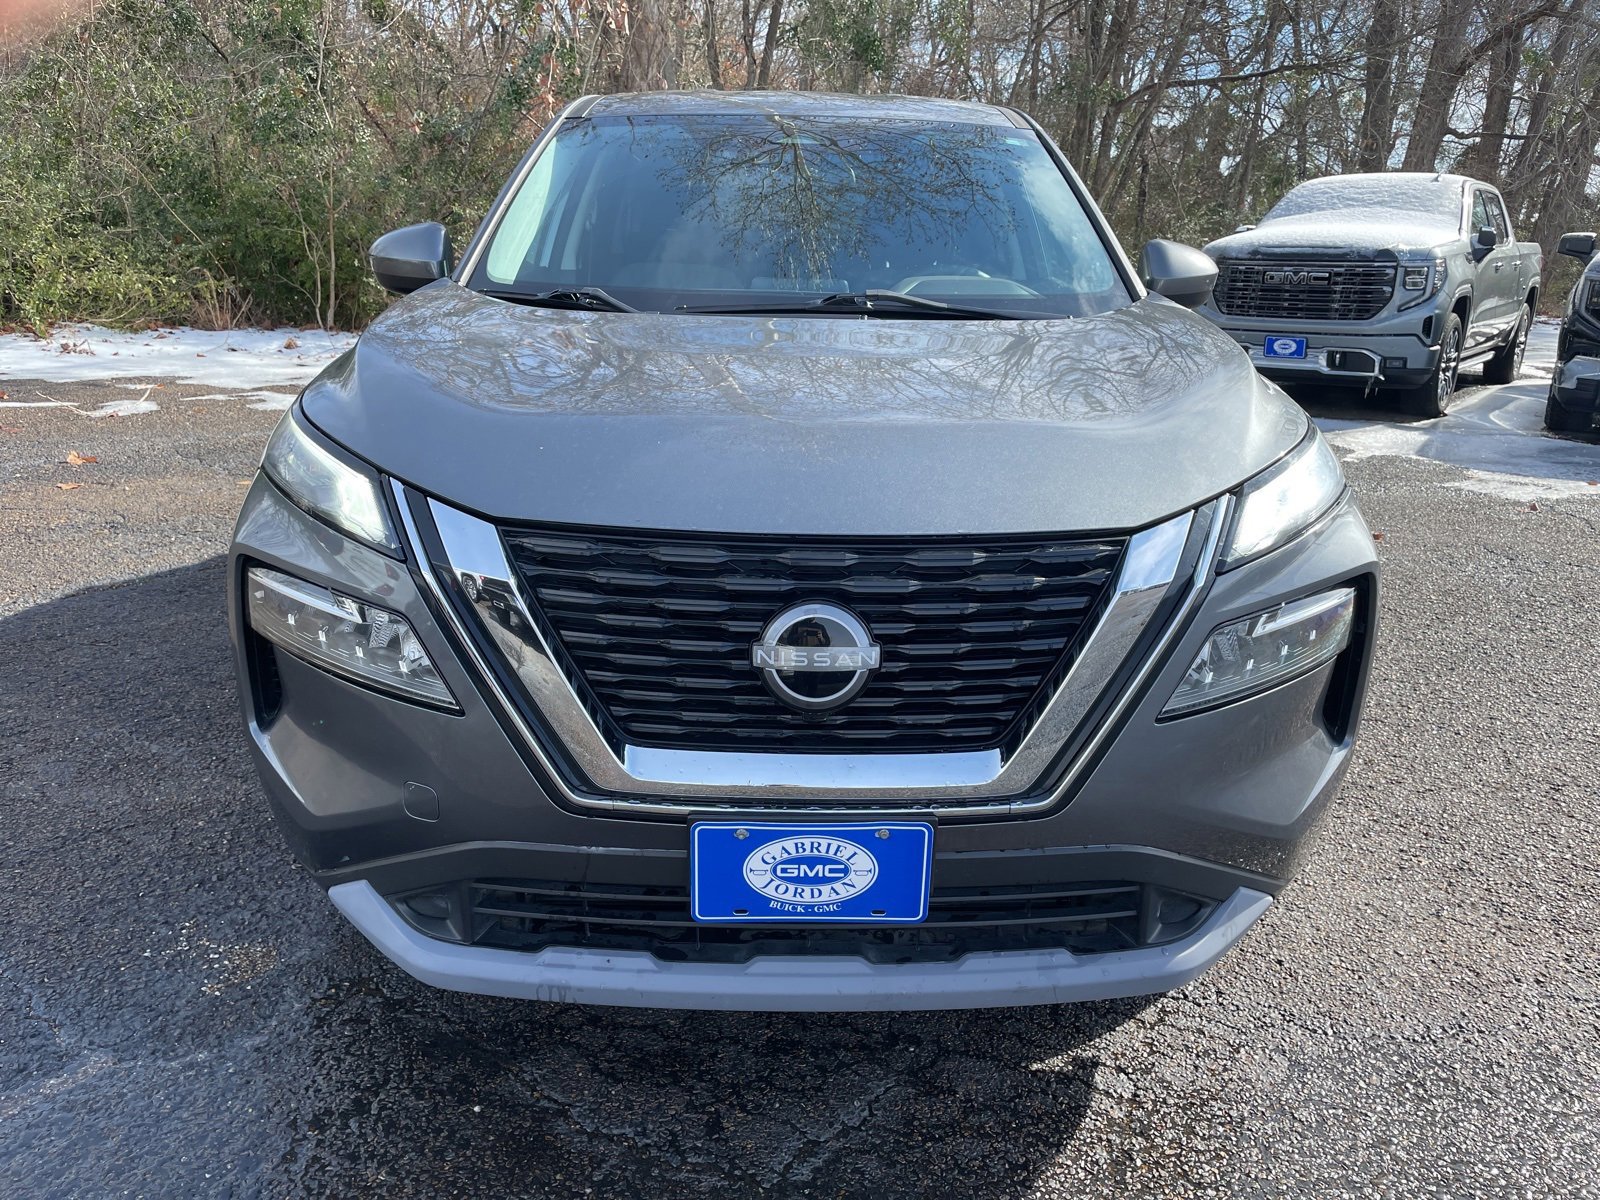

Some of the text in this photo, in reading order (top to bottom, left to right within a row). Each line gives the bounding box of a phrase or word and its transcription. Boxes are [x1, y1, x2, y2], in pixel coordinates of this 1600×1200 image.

[1264, 271, 1329, 285] GMC
[757, 650, 876, 667] NISSAN
[761, 841, 858, 866] GABRIEL
[776, 864, 845, 878] GMC
[760, 878, 857, 899] JORDAN
[769, 900, 805, 913] BUICK
[814, 902, 842, 913] GMC
